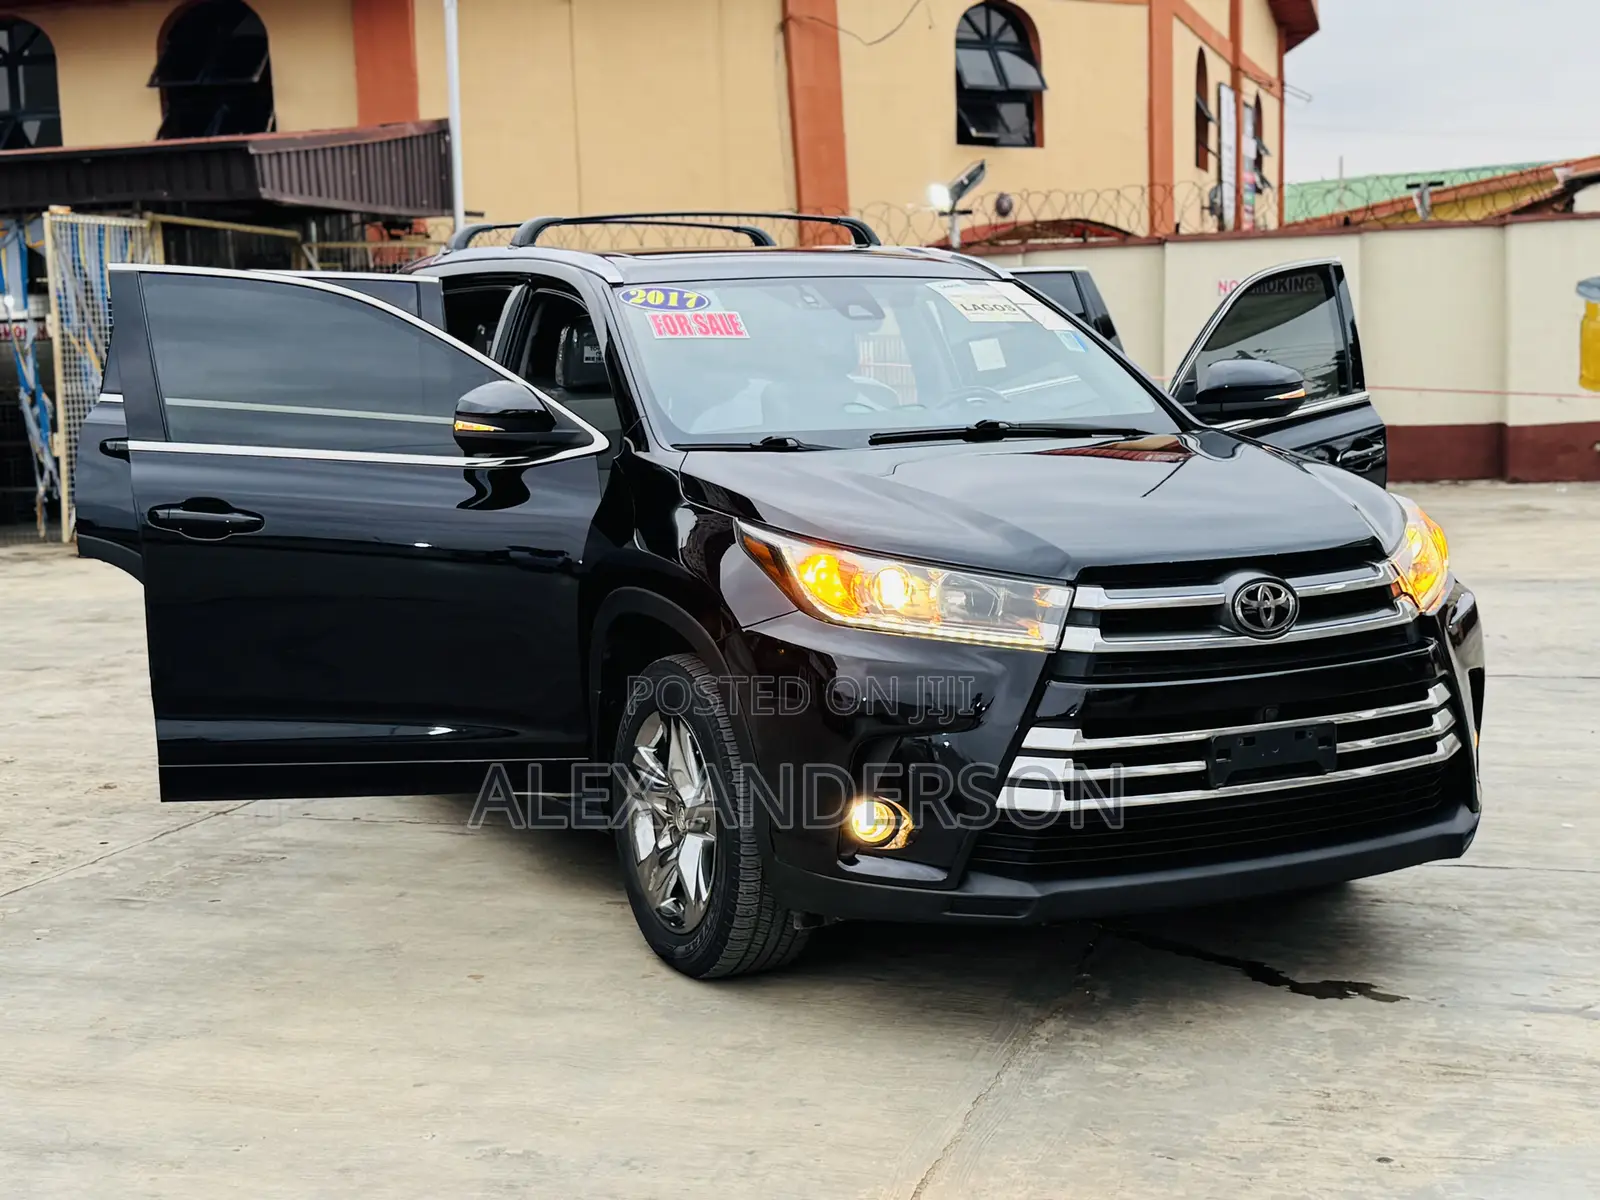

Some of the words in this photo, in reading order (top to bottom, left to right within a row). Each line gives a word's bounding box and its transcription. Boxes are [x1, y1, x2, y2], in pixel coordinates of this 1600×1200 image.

[1217, 280, 1239, 295] NO
[629, 289, 699, 309] 2017
[960, 303, 1018, 312] LAGOS
[649, 312, 695, 337] FOR
[692, 312, 744, 337] SALE
